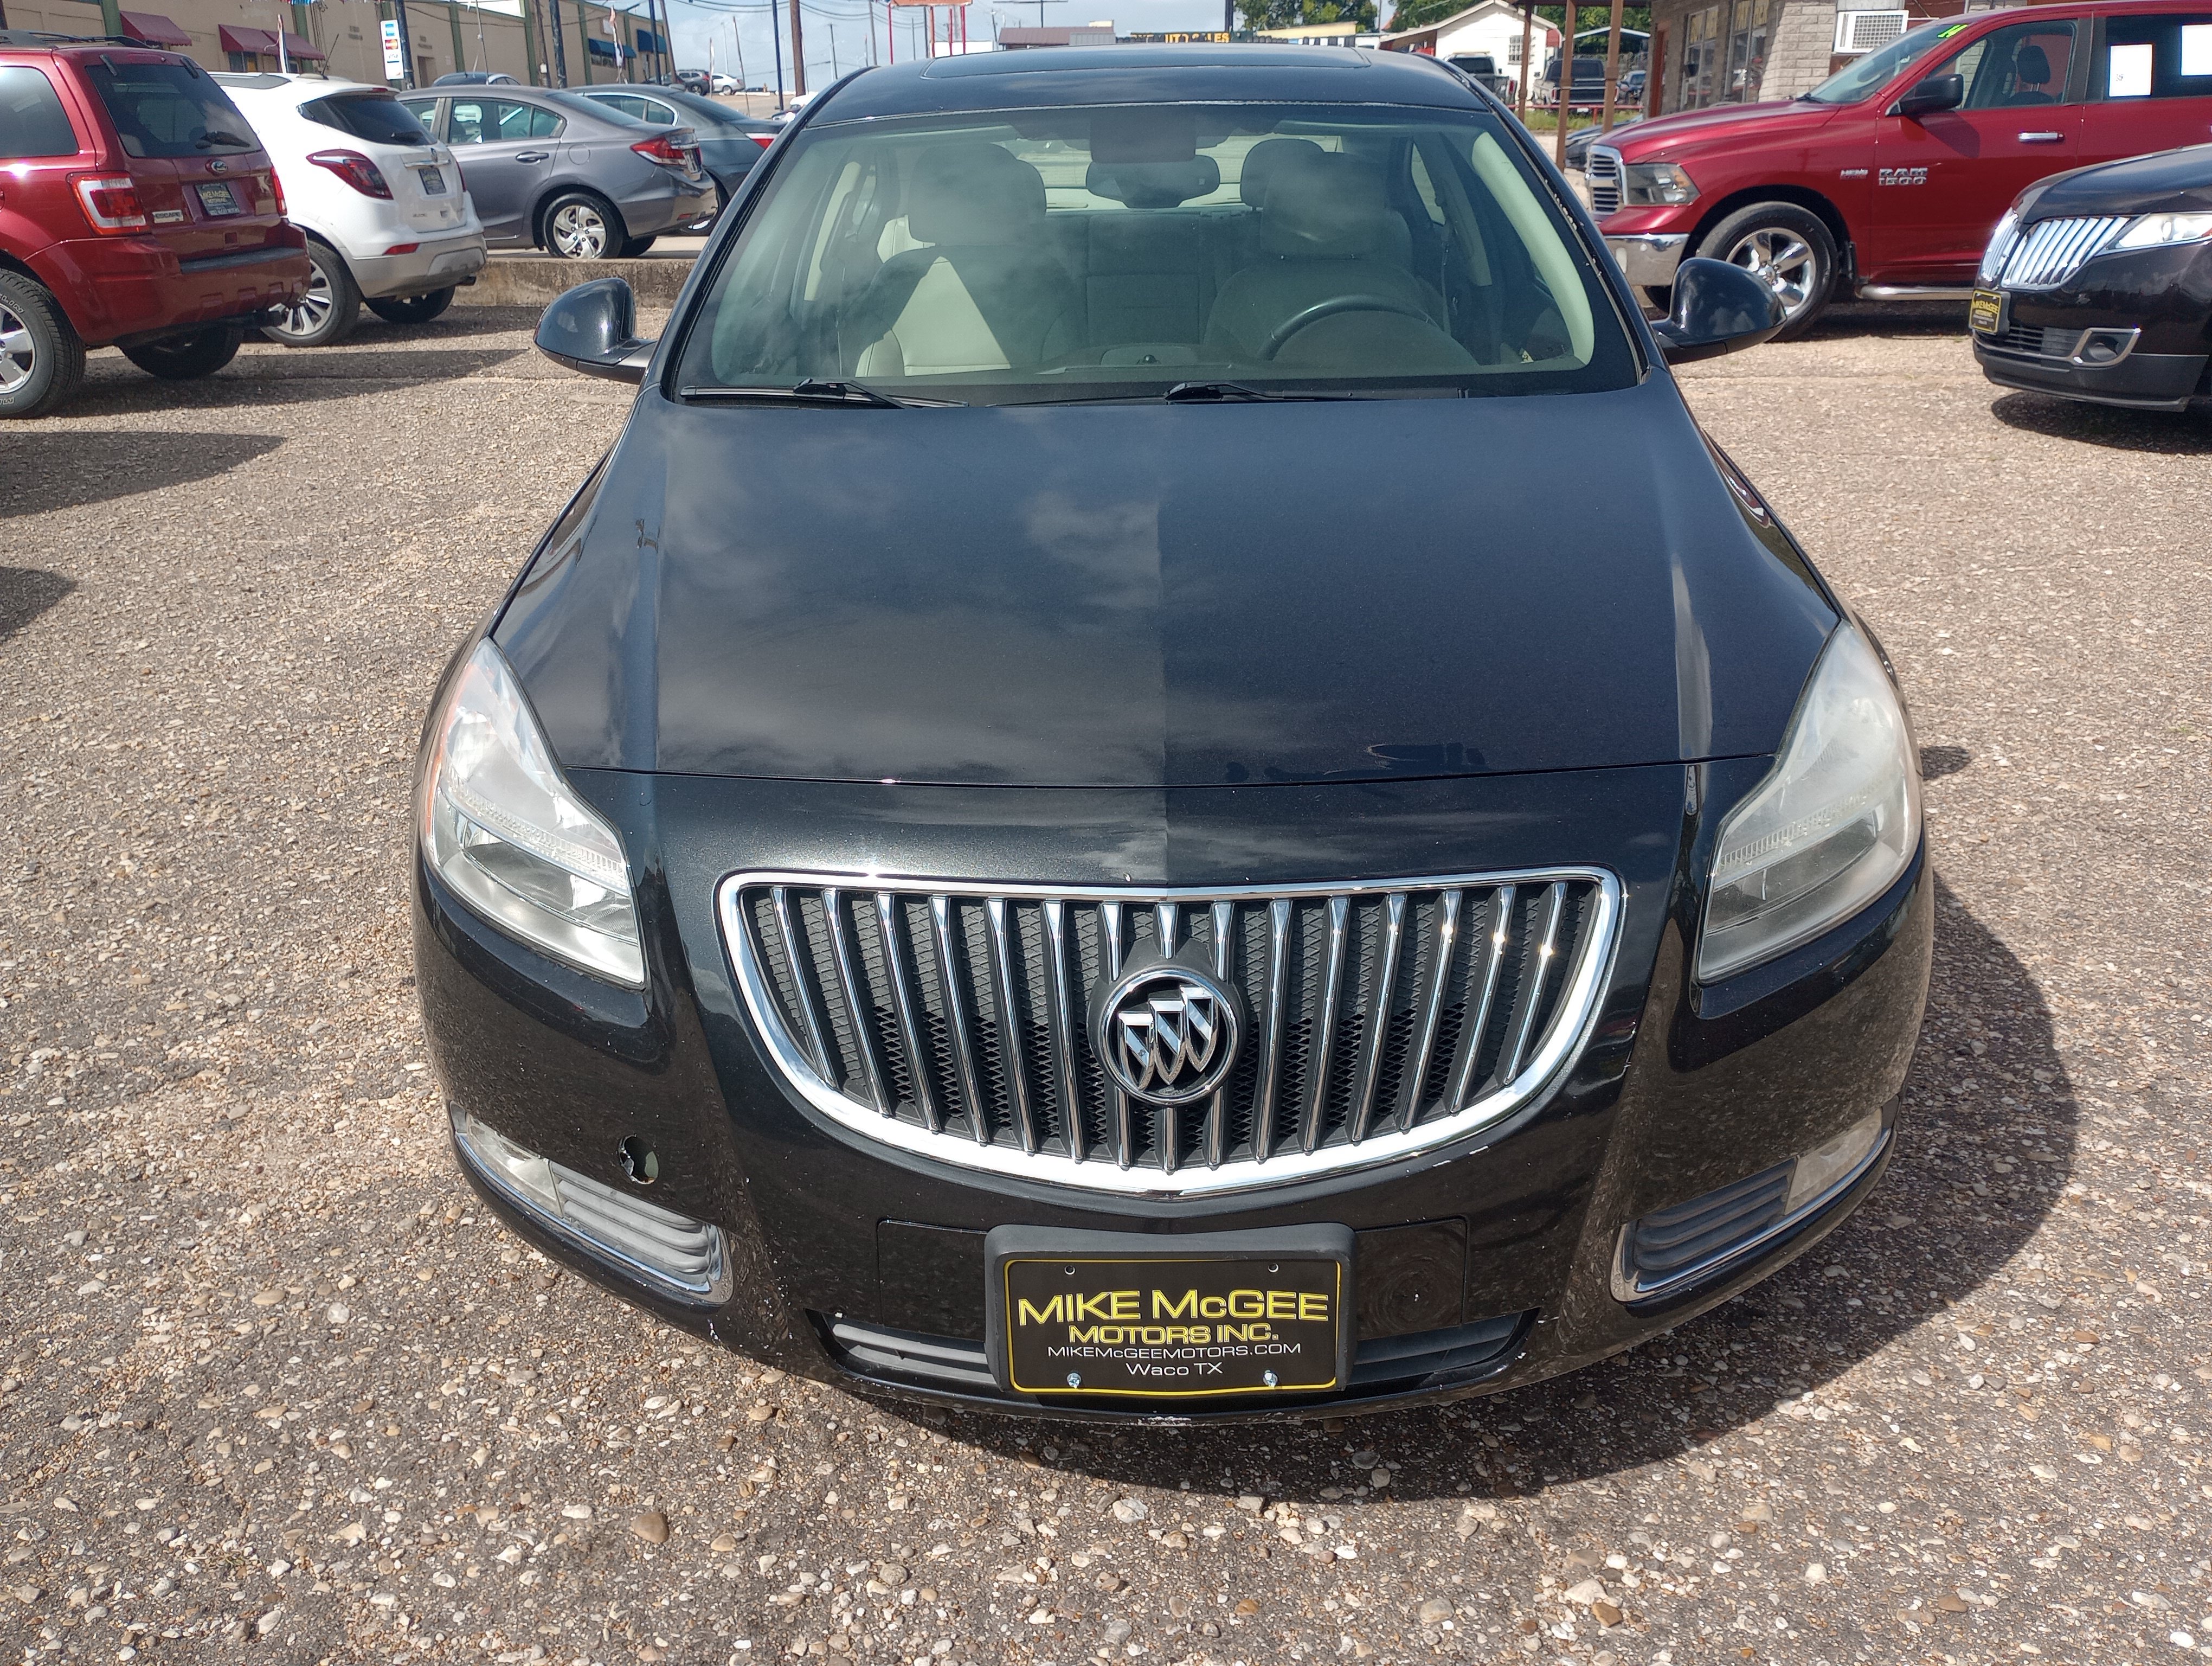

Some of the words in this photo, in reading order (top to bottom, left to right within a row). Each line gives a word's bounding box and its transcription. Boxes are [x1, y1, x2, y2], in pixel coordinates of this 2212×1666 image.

[1879, 168, 1928, 177] RAM
[1879, 177, 1927, 185] 1500
[1019, 1290, 1141, 1326] MIKE
[1152, 1289, 1329, 1322] McGEE
[1069, 1325, 1211, 1345] MOTORS
[1217, 1323, 1279, 1343] INC.
[1047, 1343, 1302, 1359] MIKEMcGEEMOTORS.COM
[1126, 1362, 1189, 1376] Waco
[1193, 1361, 1224, 1375] TX
